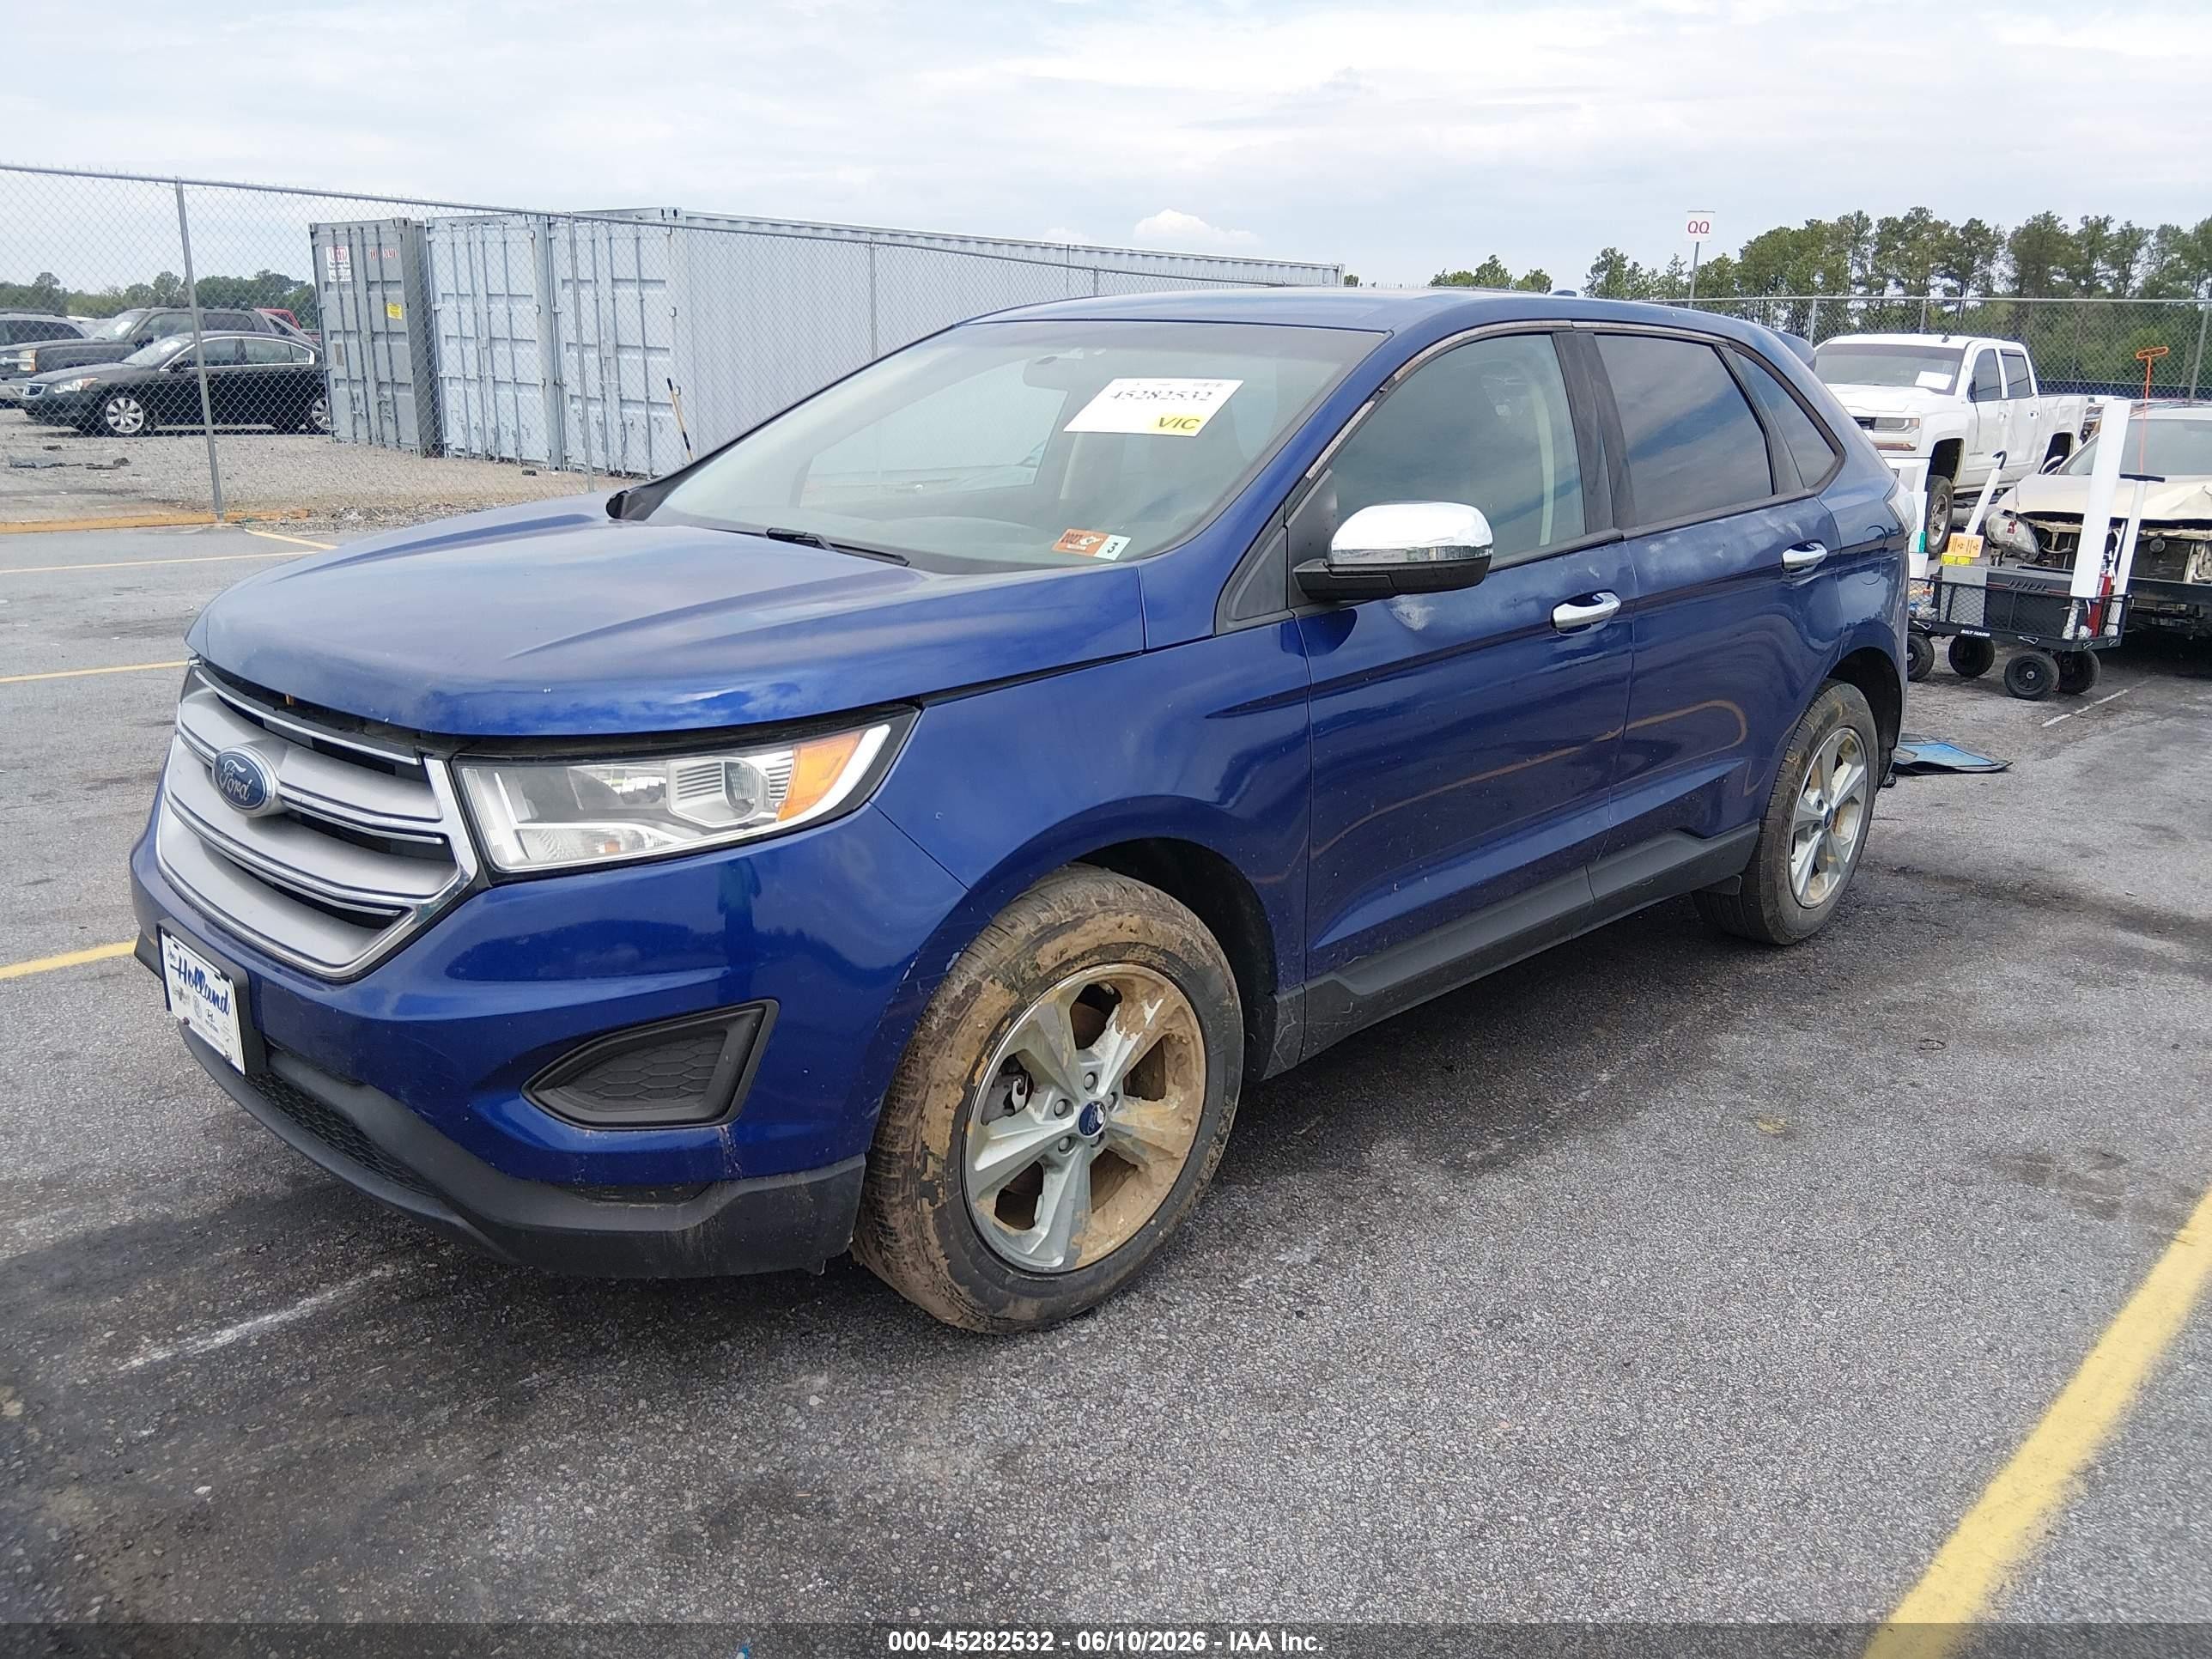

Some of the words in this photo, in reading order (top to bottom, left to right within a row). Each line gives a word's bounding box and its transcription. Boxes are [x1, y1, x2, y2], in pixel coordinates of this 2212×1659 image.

[1158, 417, 1200, 429] VIC
[1107, 542, 1119, 554] 3
[219, 759, 252, 801] Ford
[170, 955, 230, 1017] Holland
